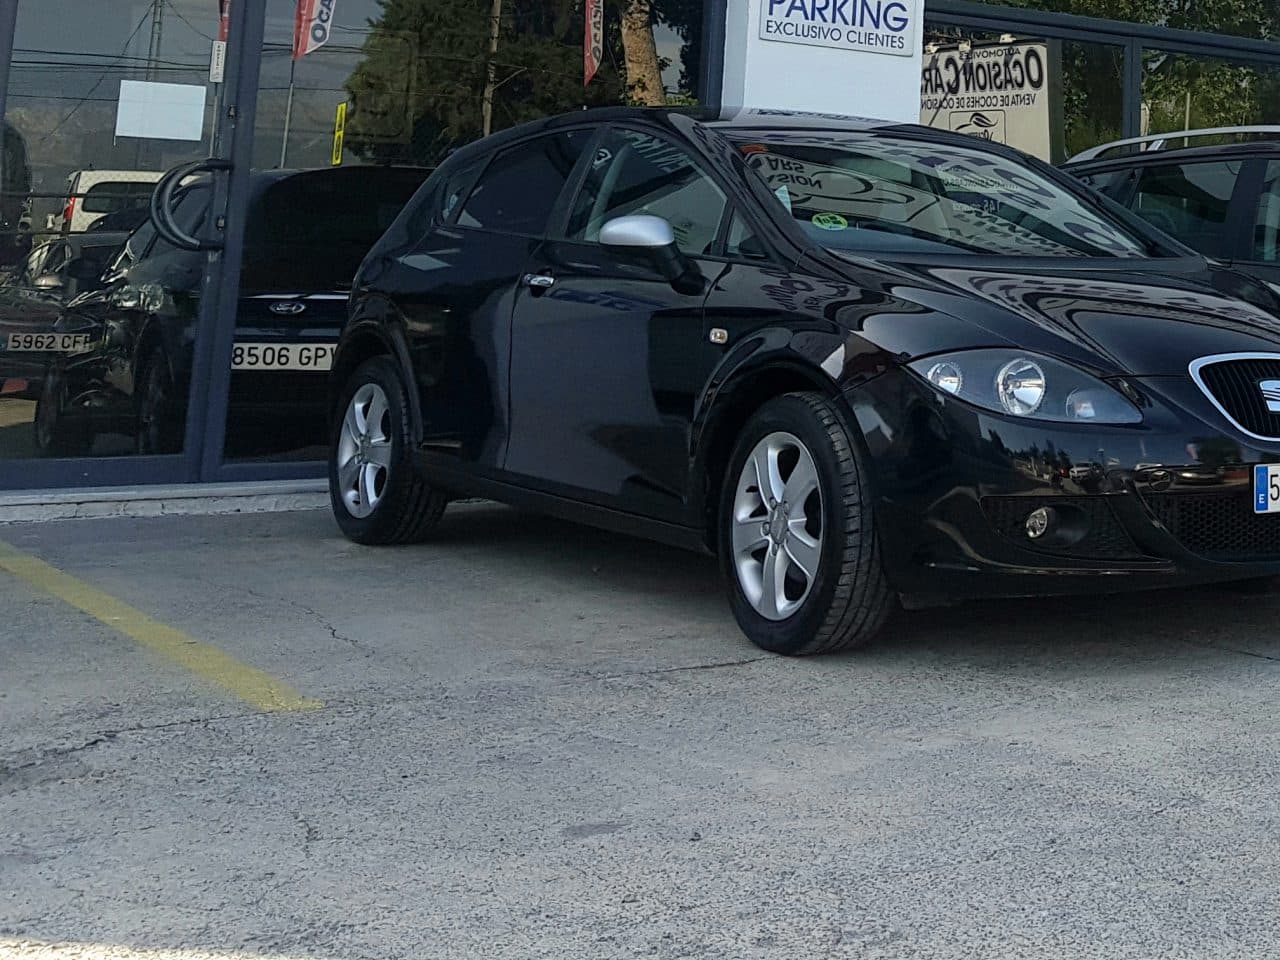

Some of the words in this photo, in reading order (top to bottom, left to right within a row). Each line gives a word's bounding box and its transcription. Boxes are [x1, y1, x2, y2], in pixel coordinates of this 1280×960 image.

[766, 20, 842, 41] EXCLUSIVO
[847, 30, 905, 49] CLIENTES
[11, 335, 56, 349] 5962
[232, 346, 290, 365] 8506
